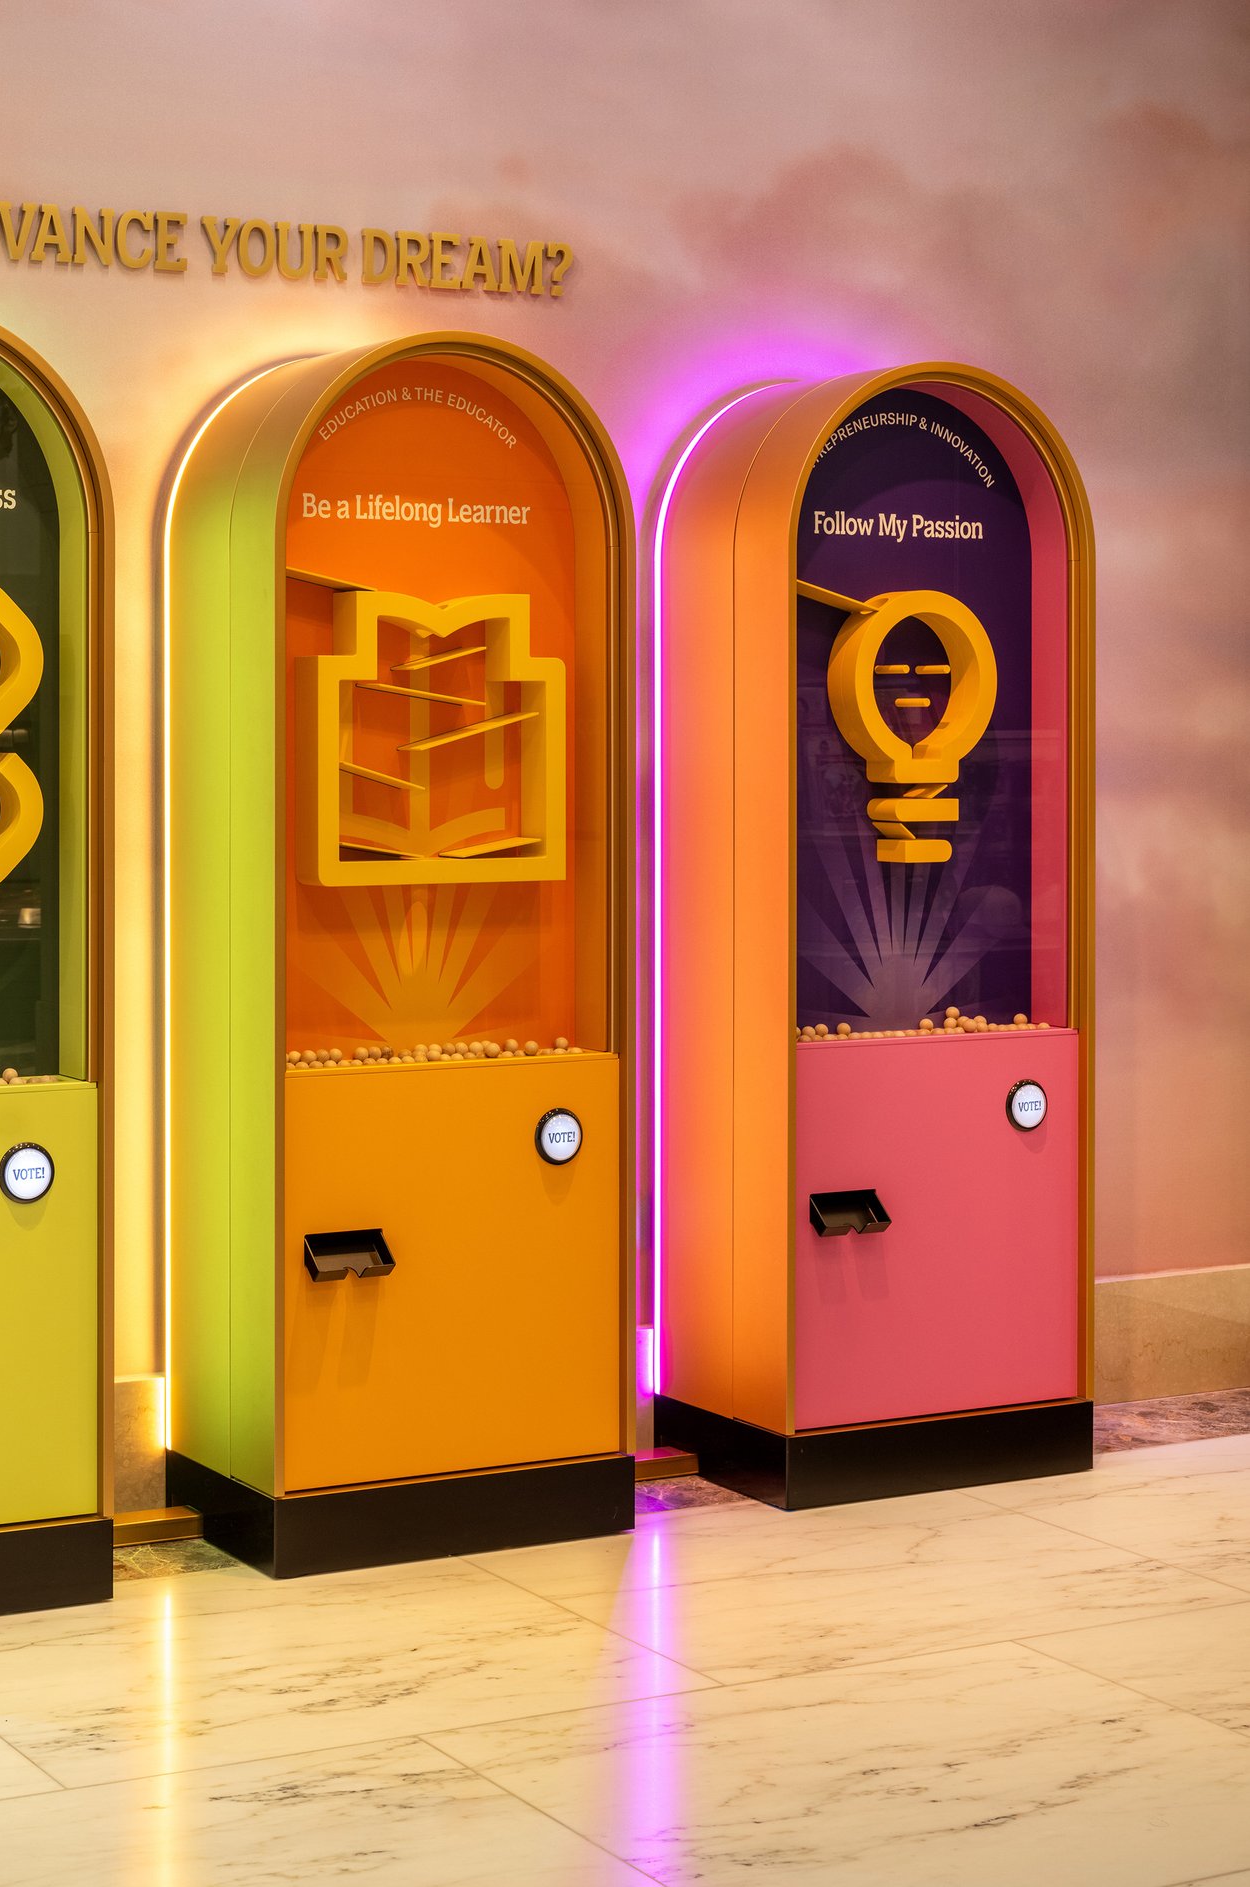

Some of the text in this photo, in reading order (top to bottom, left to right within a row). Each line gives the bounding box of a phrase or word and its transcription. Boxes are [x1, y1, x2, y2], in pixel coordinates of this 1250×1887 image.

[200, 215, 348, 282] YOUR
[360, 227, 575, 297] DREAM?
[318, 386, 518, 449] EDUCATION & THE EDUCATOR
[918, 417, 928, 431] &
[930, 421, 996, 489] INNOVATION
[302, 492, 531, 528] Be a Lifelong Learner
[813, 510, 984, 543] Follow My Passion
[1017, 1100, 1042, 1113] VOTE!
[548, 1131, 576, 1144] VOTE!
[12, 1166, 45, 1181] VOTE!
